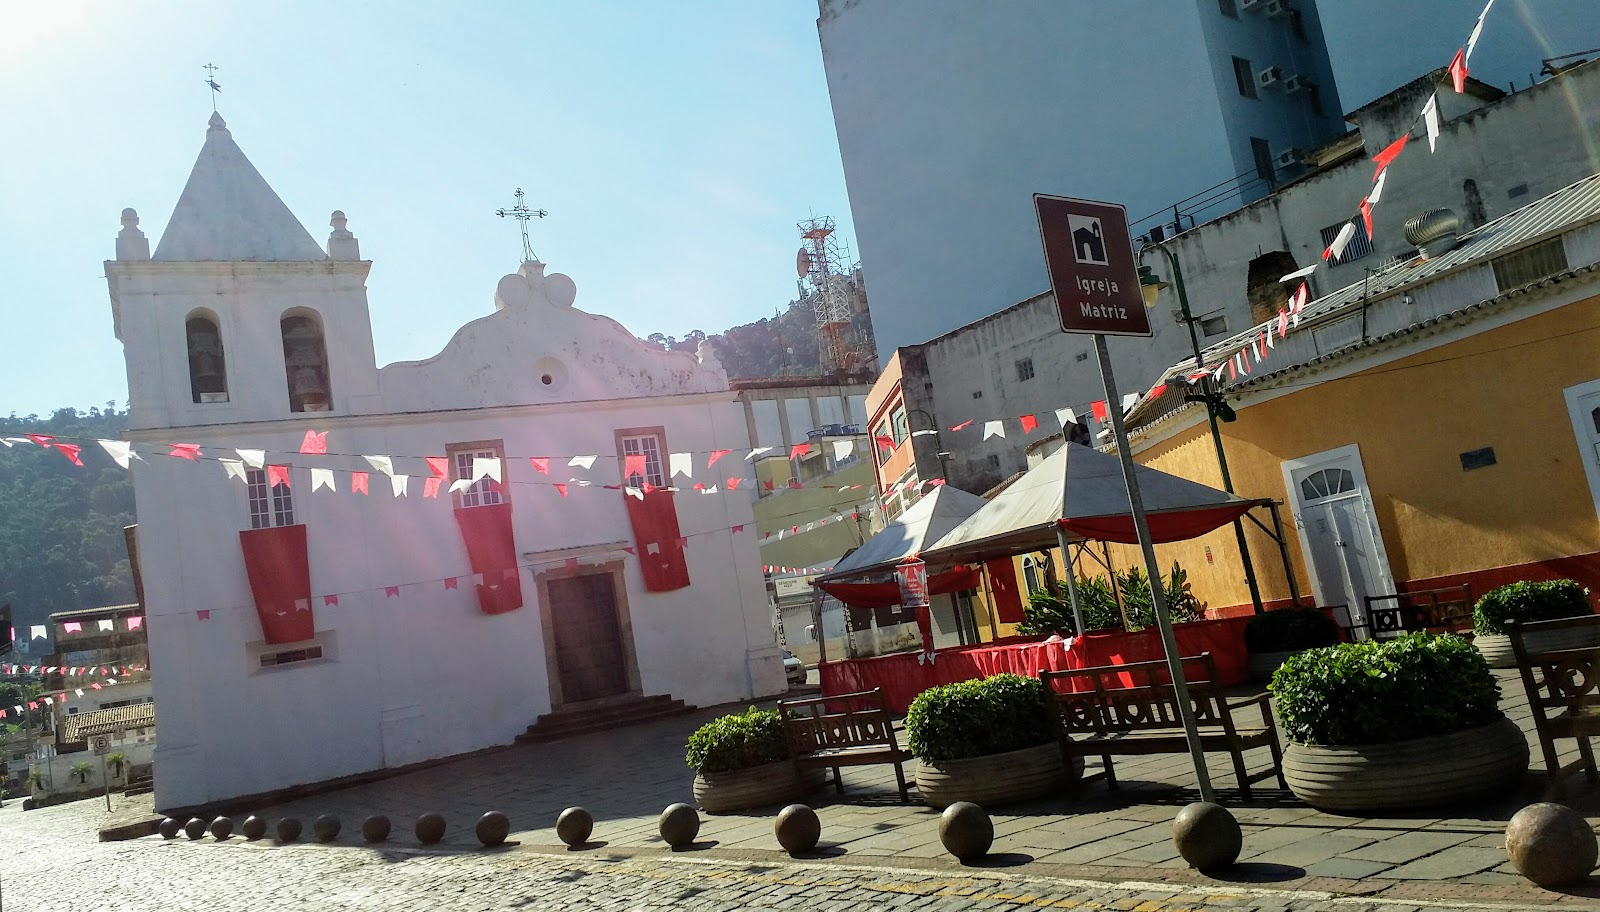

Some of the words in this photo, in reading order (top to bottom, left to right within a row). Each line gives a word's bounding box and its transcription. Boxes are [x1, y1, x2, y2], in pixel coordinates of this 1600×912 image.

[1076, 275, 1119, 297] Igreja
[1080, 301, 1128, 320] Matriz
[98, 739, 104, 748] E
